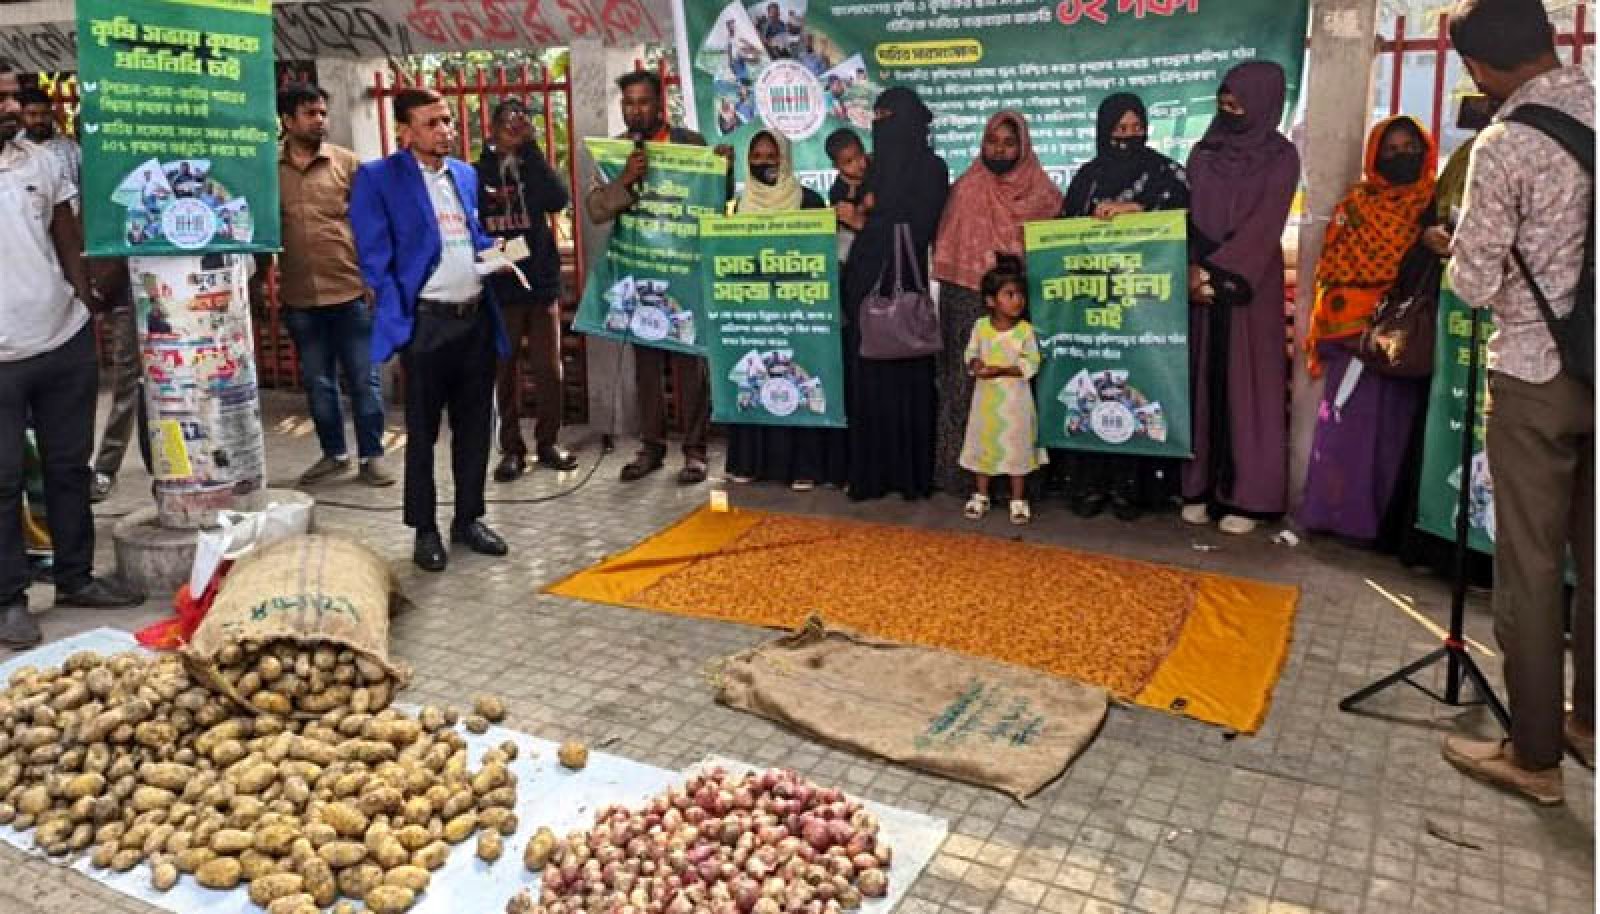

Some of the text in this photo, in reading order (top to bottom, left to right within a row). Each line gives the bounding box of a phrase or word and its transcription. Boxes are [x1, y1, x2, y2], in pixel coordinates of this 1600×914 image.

[90, 16, 137, 47] কৃষি
[205, 32, 260, 58] কৃষক
[114, 46, 241, 81] প্রতিনিধি চাই
[713, 254, 756, 278] সেচ
[760, 248, 827, 279] মিটার
[1040, 272, 1173, 307] ন্যায্য মূল্য
[1085, 302, 1122, 330] চাই
